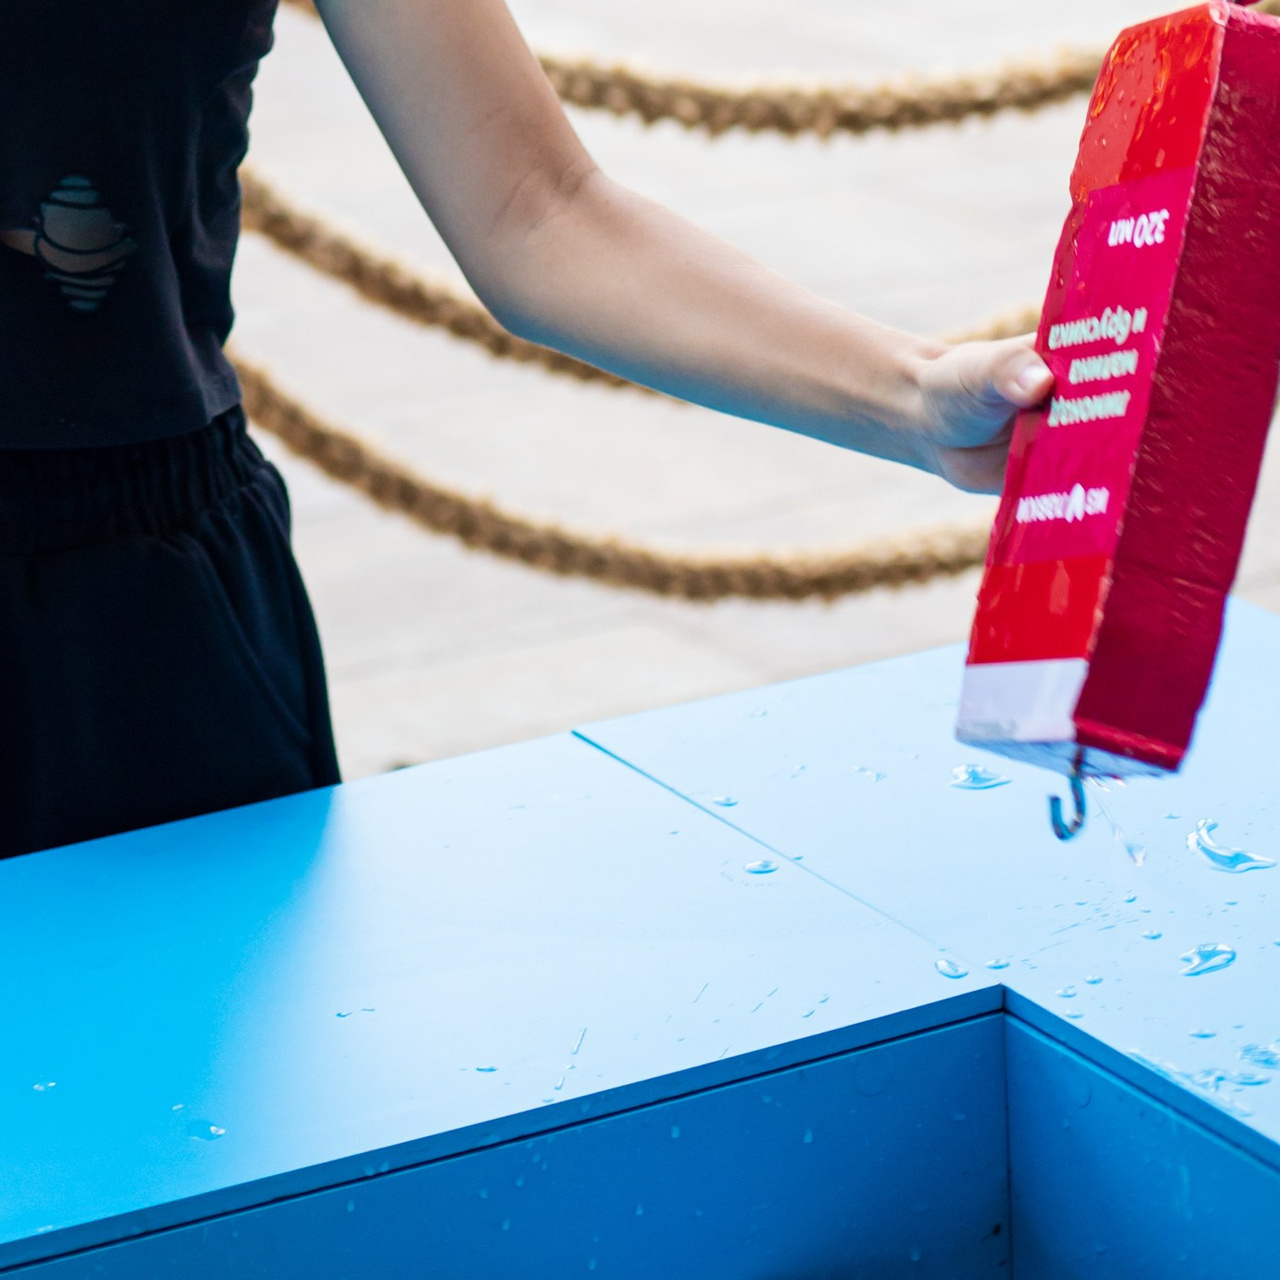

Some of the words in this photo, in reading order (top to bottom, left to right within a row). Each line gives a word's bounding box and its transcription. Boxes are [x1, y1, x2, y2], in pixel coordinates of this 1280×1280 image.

[1108, 217, 1135, 247] мл
[1134, 208, 1169, 249] 320
[1048, 305, 1133, 350] брусника
[1133, 308, 1148, 334] и
[1068, 349, 1139, 385] малина
[1047, 389, 1131, 427] лимонад
